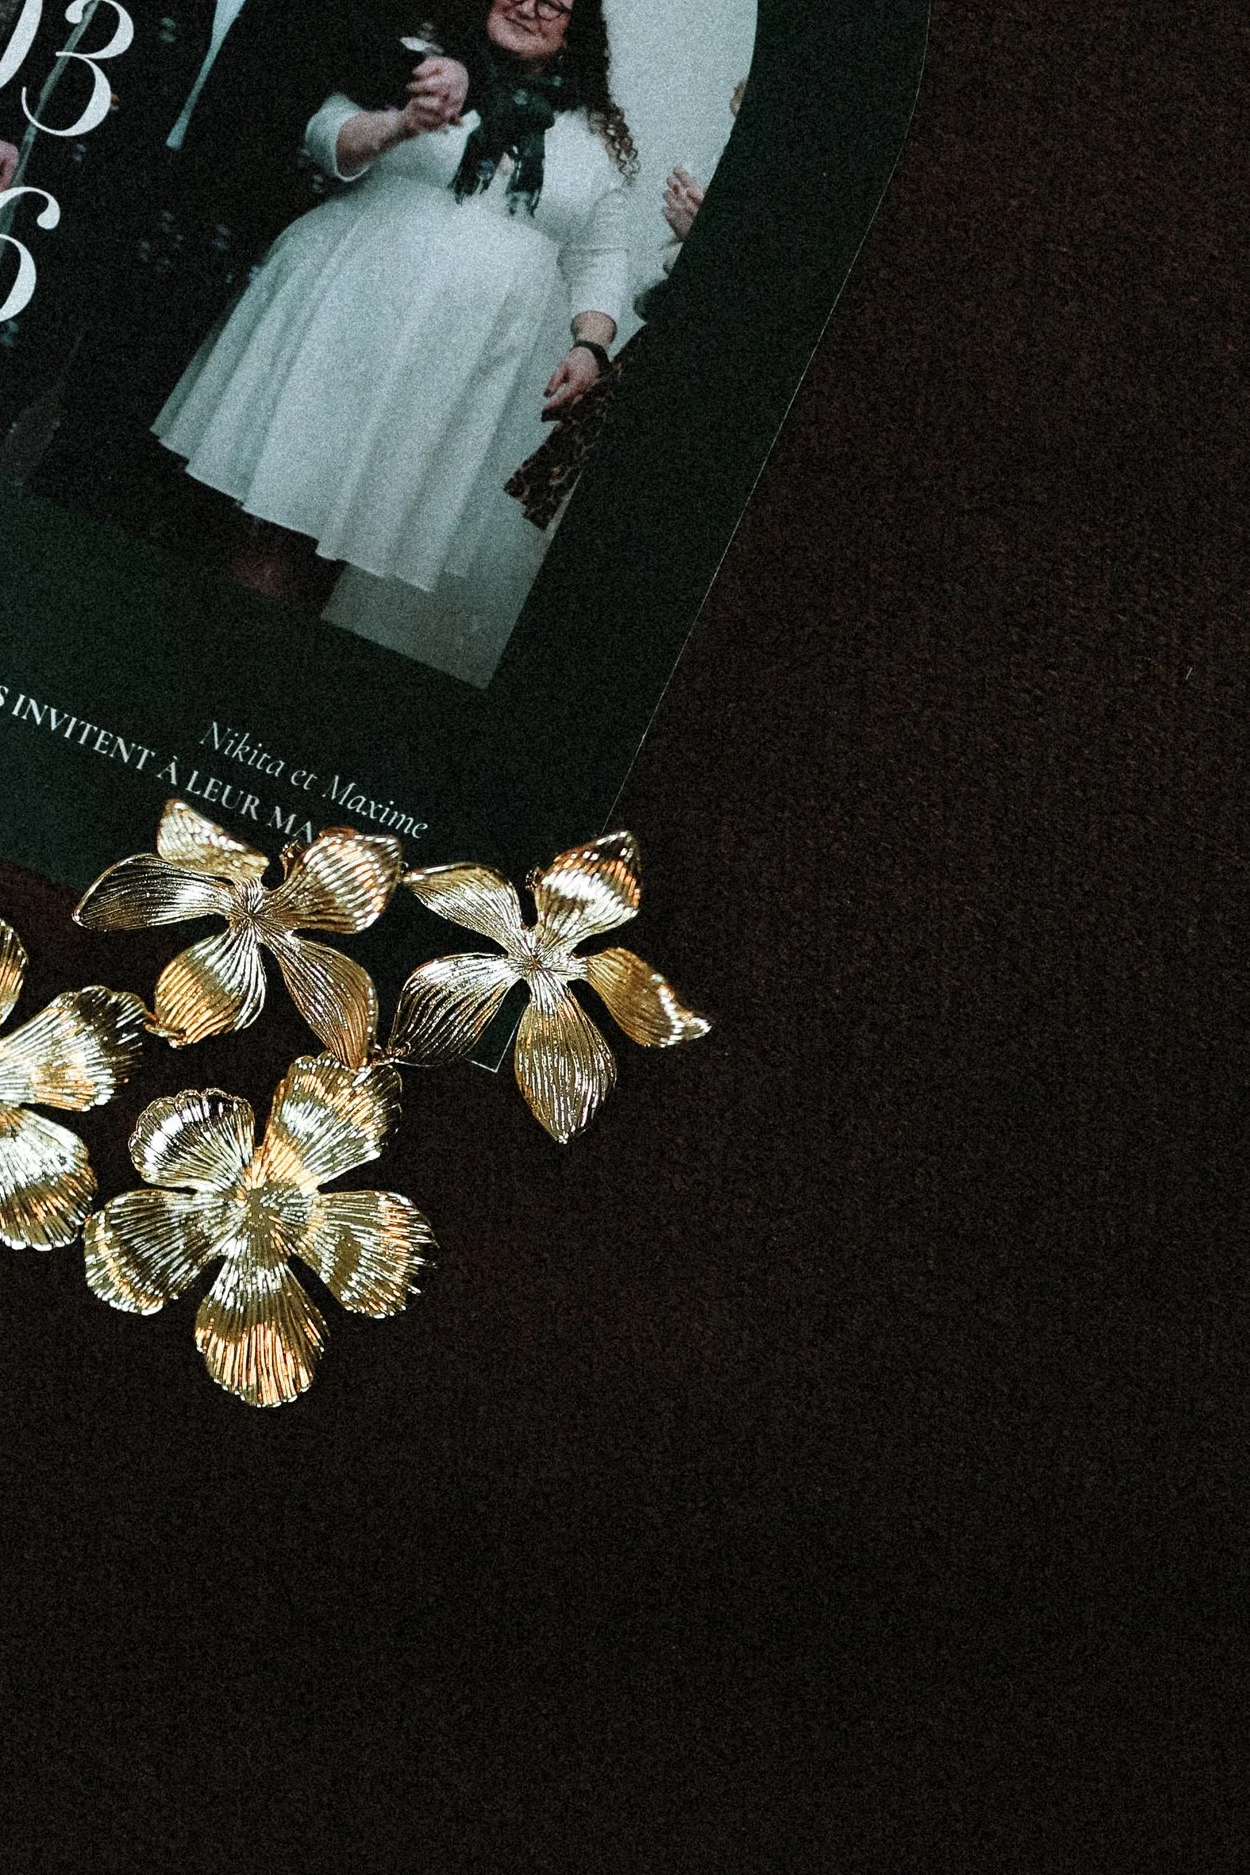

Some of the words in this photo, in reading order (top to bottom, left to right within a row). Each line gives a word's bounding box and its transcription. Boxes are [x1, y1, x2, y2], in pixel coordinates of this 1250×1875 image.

[11, 693, 156, 771] INVITENT
[157, 755, 178, 785] À
[185, 770, 261, 821] LEUR
[268, 806, 313, 844] MA
[199, 721, 286, 778] Nikita
[290, 769, 318, 791] et
[322, 775, 429, 839] Maxime
